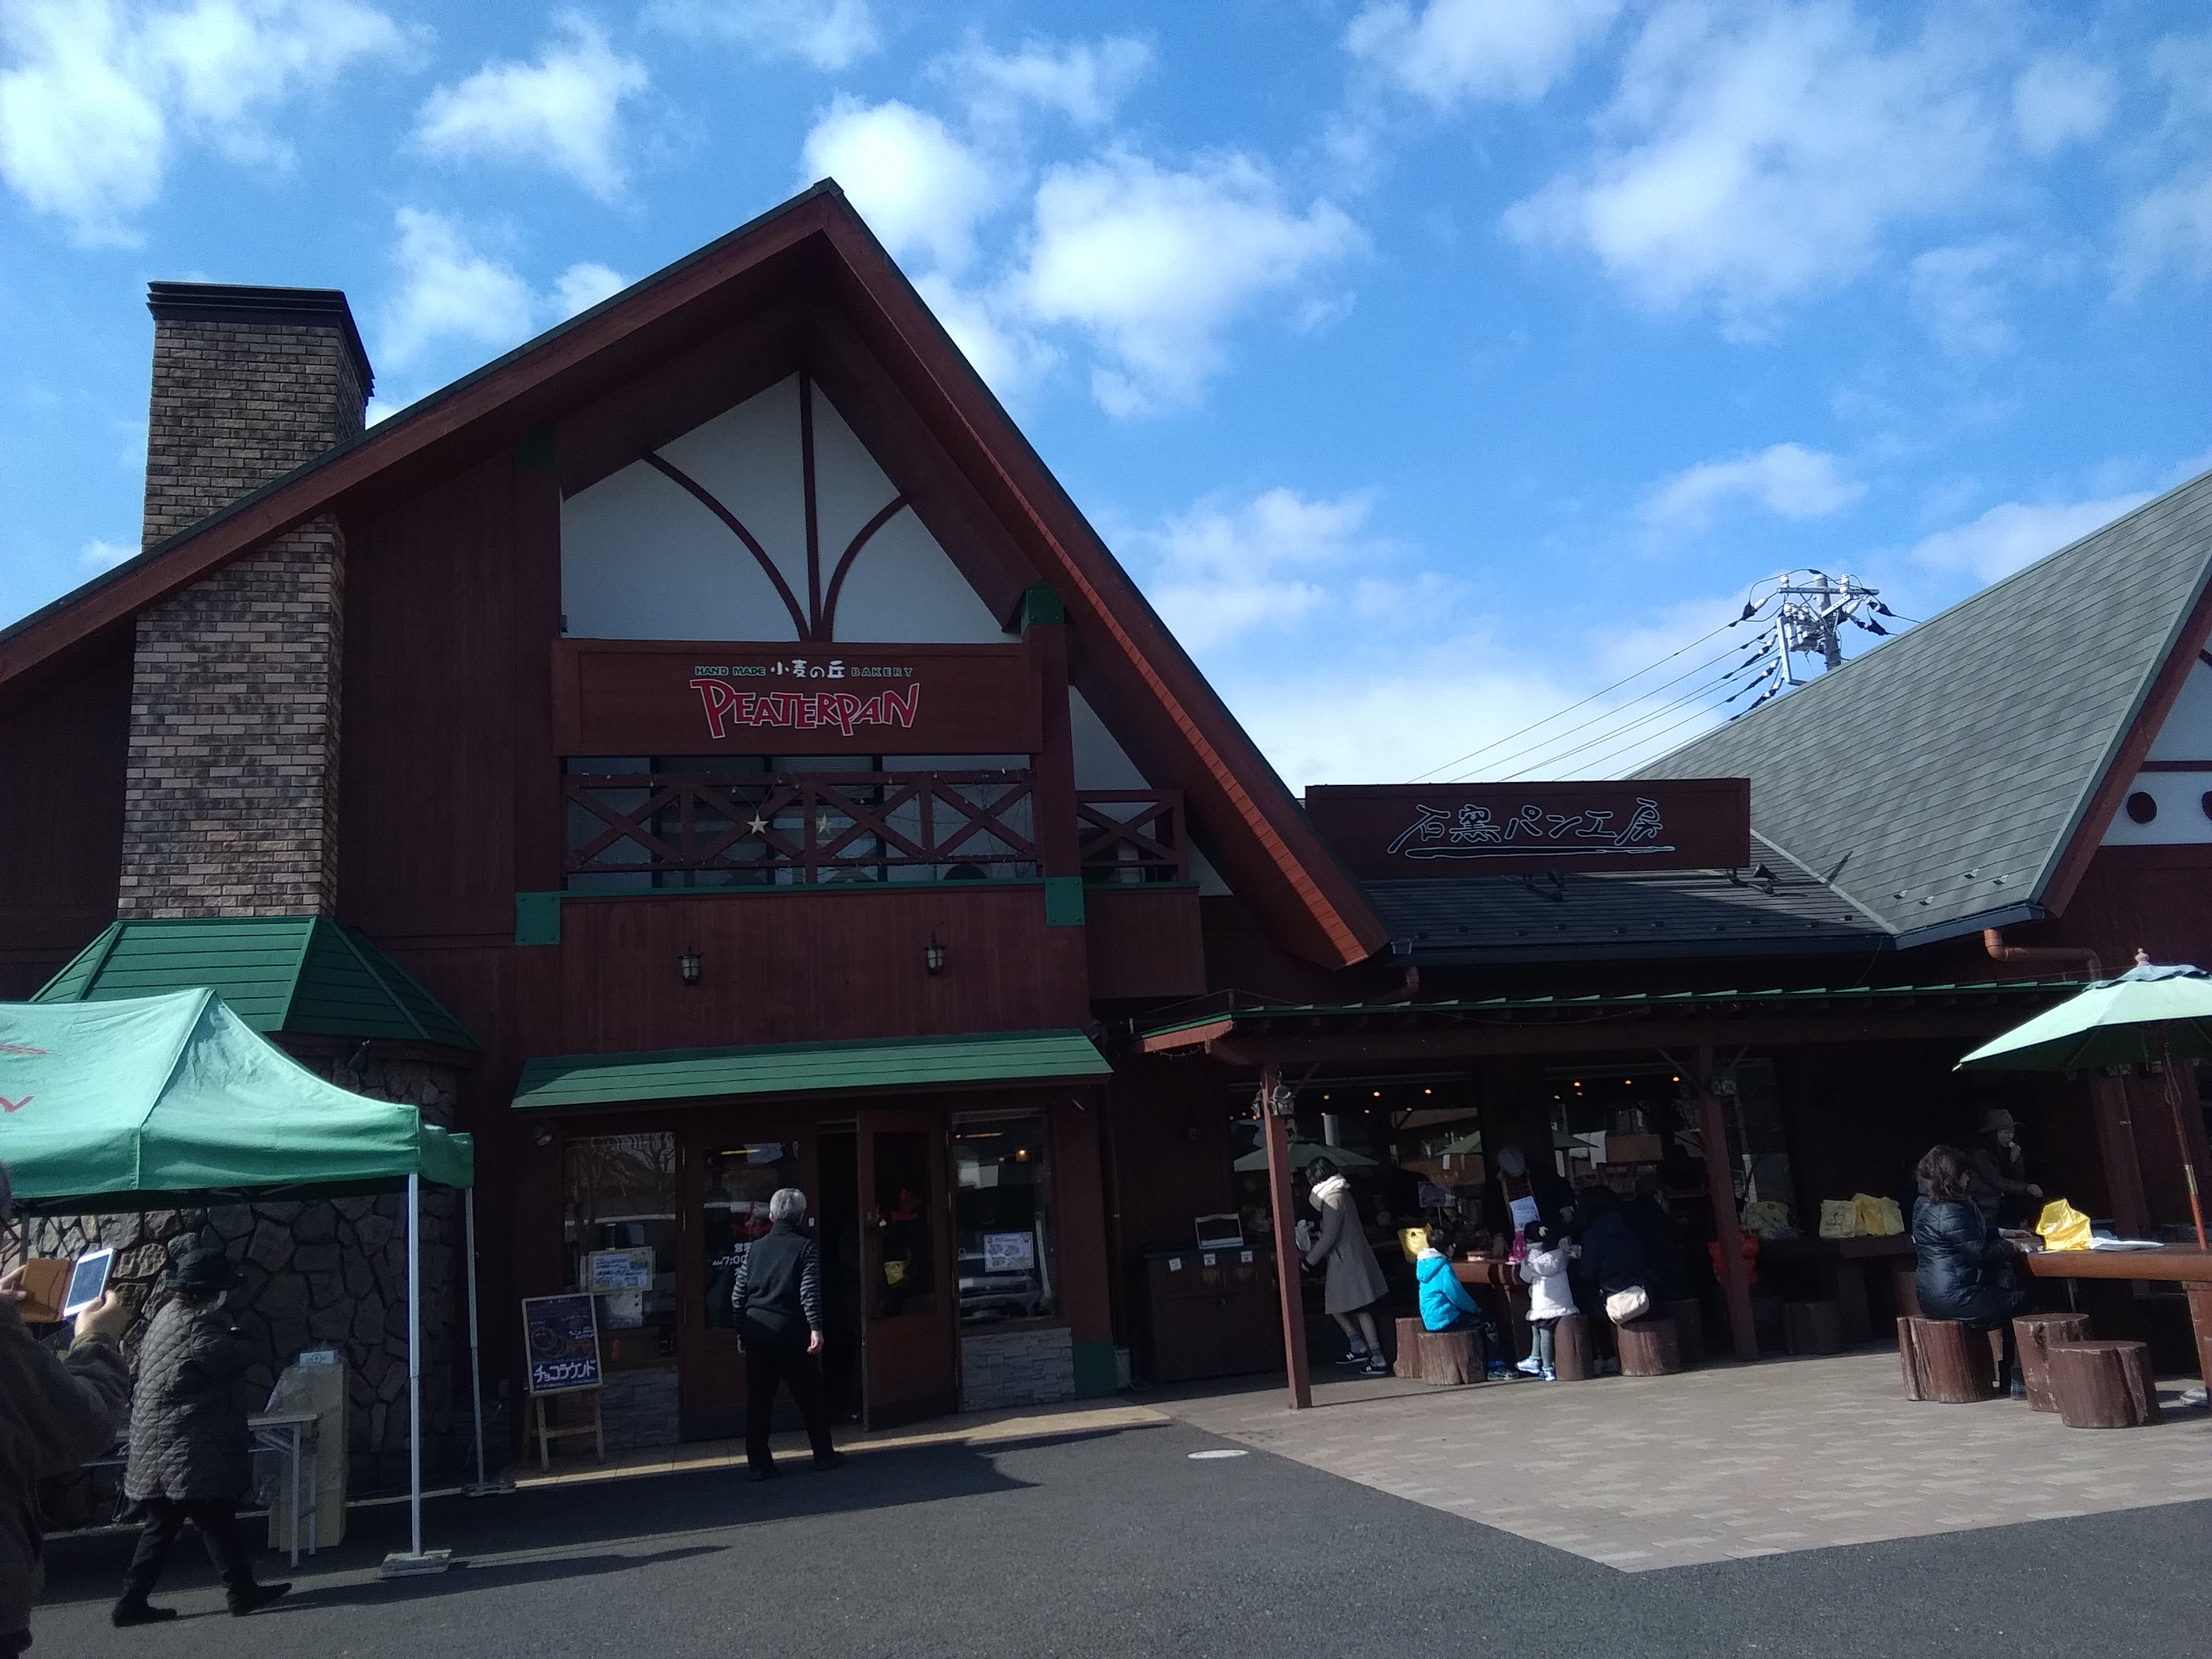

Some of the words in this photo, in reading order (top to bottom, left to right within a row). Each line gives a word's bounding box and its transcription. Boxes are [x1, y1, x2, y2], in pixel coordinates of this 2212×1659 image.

[695, 665, 729, 676] HAND
[733, 665, 766, 677] MADE
[771, 659, 845, 678] 小麦の丘
[851, 667, 913, 677] BAKERY
[690, 678, 920, 739] PEATERPAN
[1387, 797, 1663, 854] 石窯パン工房
